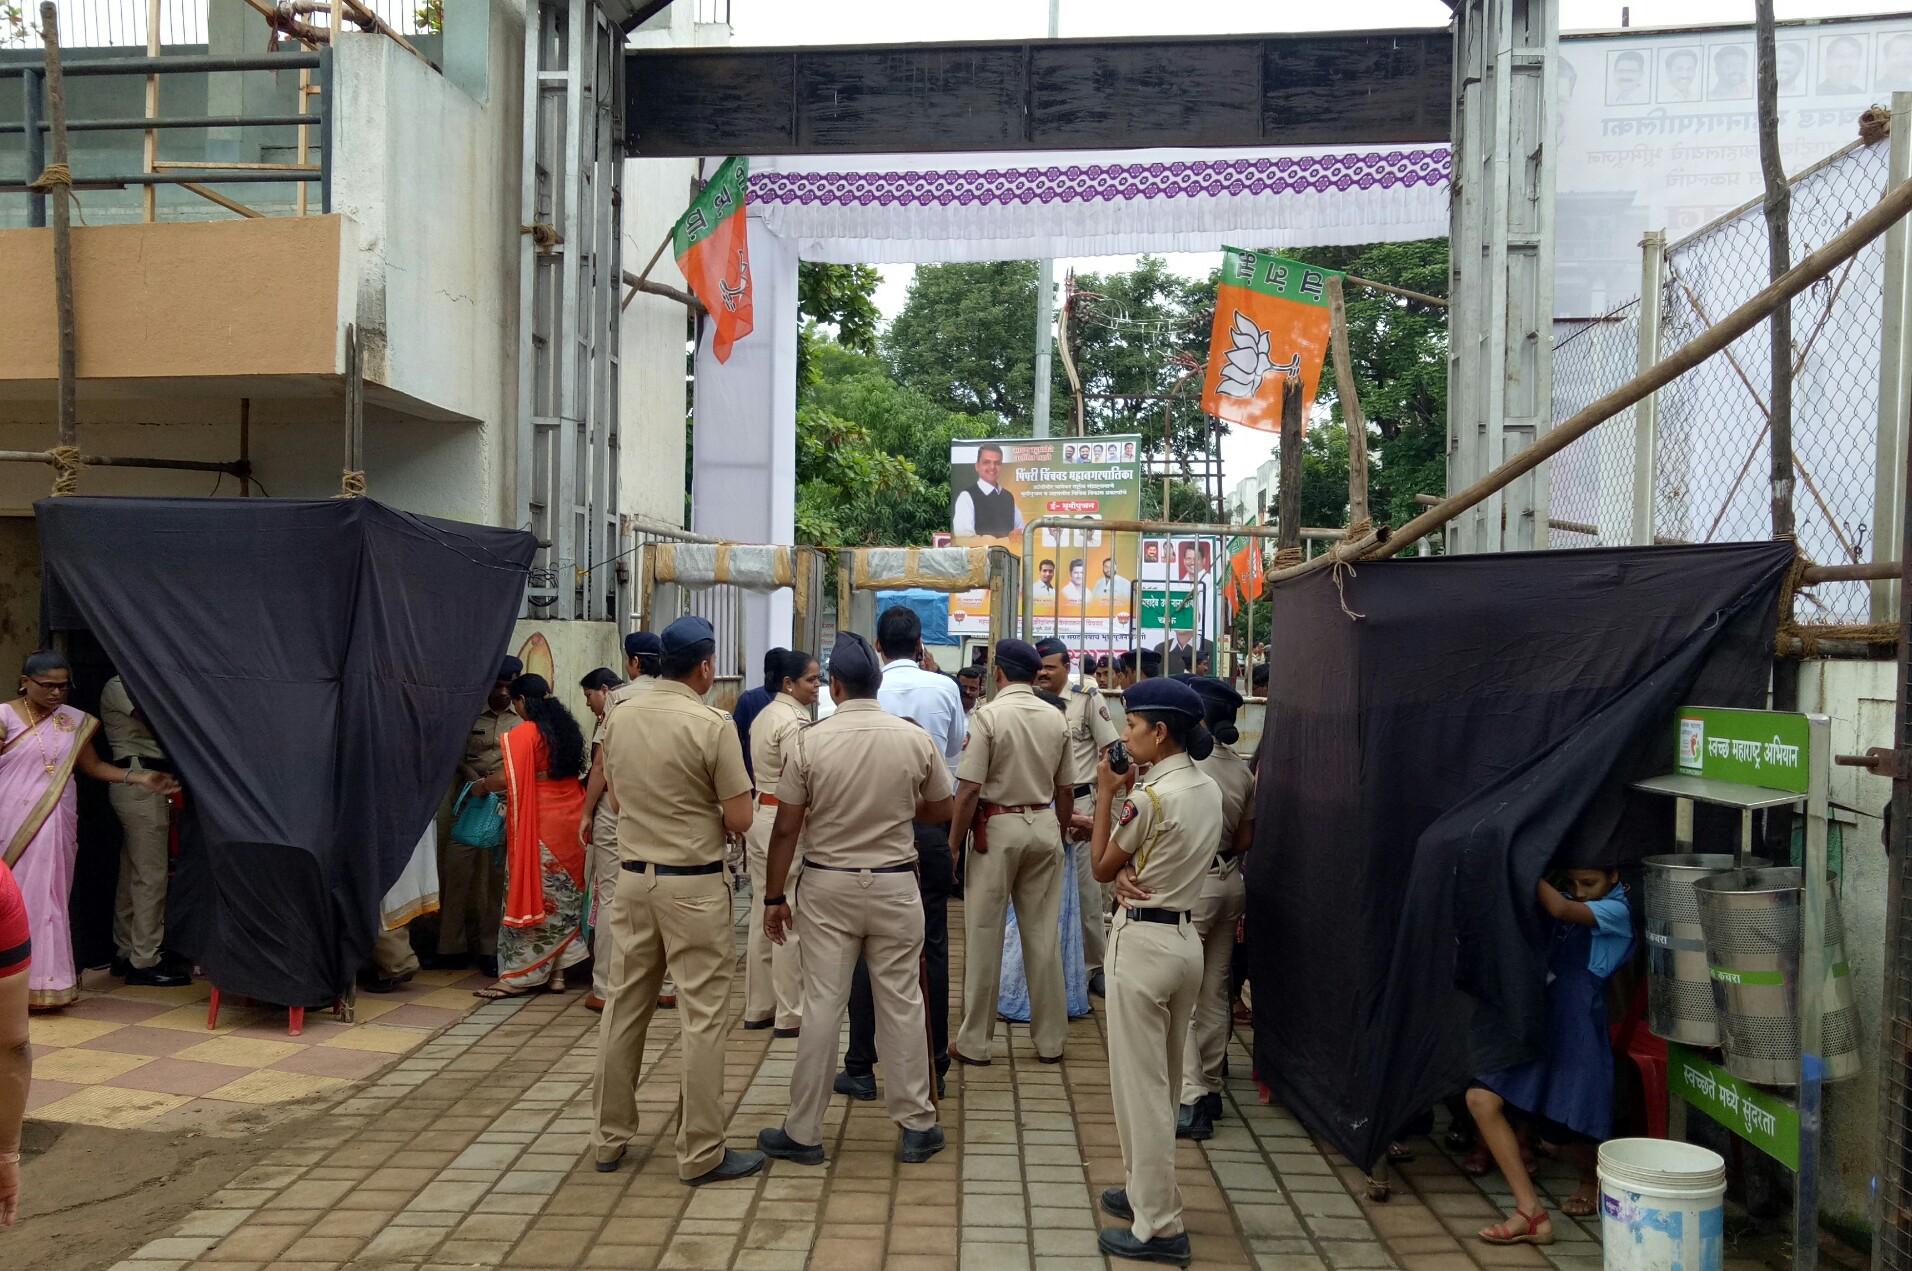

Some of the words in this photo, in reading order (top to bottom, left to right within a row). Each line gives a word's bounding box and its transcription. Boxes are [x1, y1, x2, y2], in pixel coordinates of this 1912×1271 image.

[1708, 736, 1730, 758] स्वच्छ
[1731, 739, 1762, 769] महाराष्ट्र
[1764, 734, 1799, 768] अभियान
[1718, 970, 1741, 984] कचरा
[1683, 1063, 1716, 1100] स्वच्छते
[1718, 1084, 1740, 1115] मध्ये
[1742, 1097, 1777, 1137] सुंदरता
